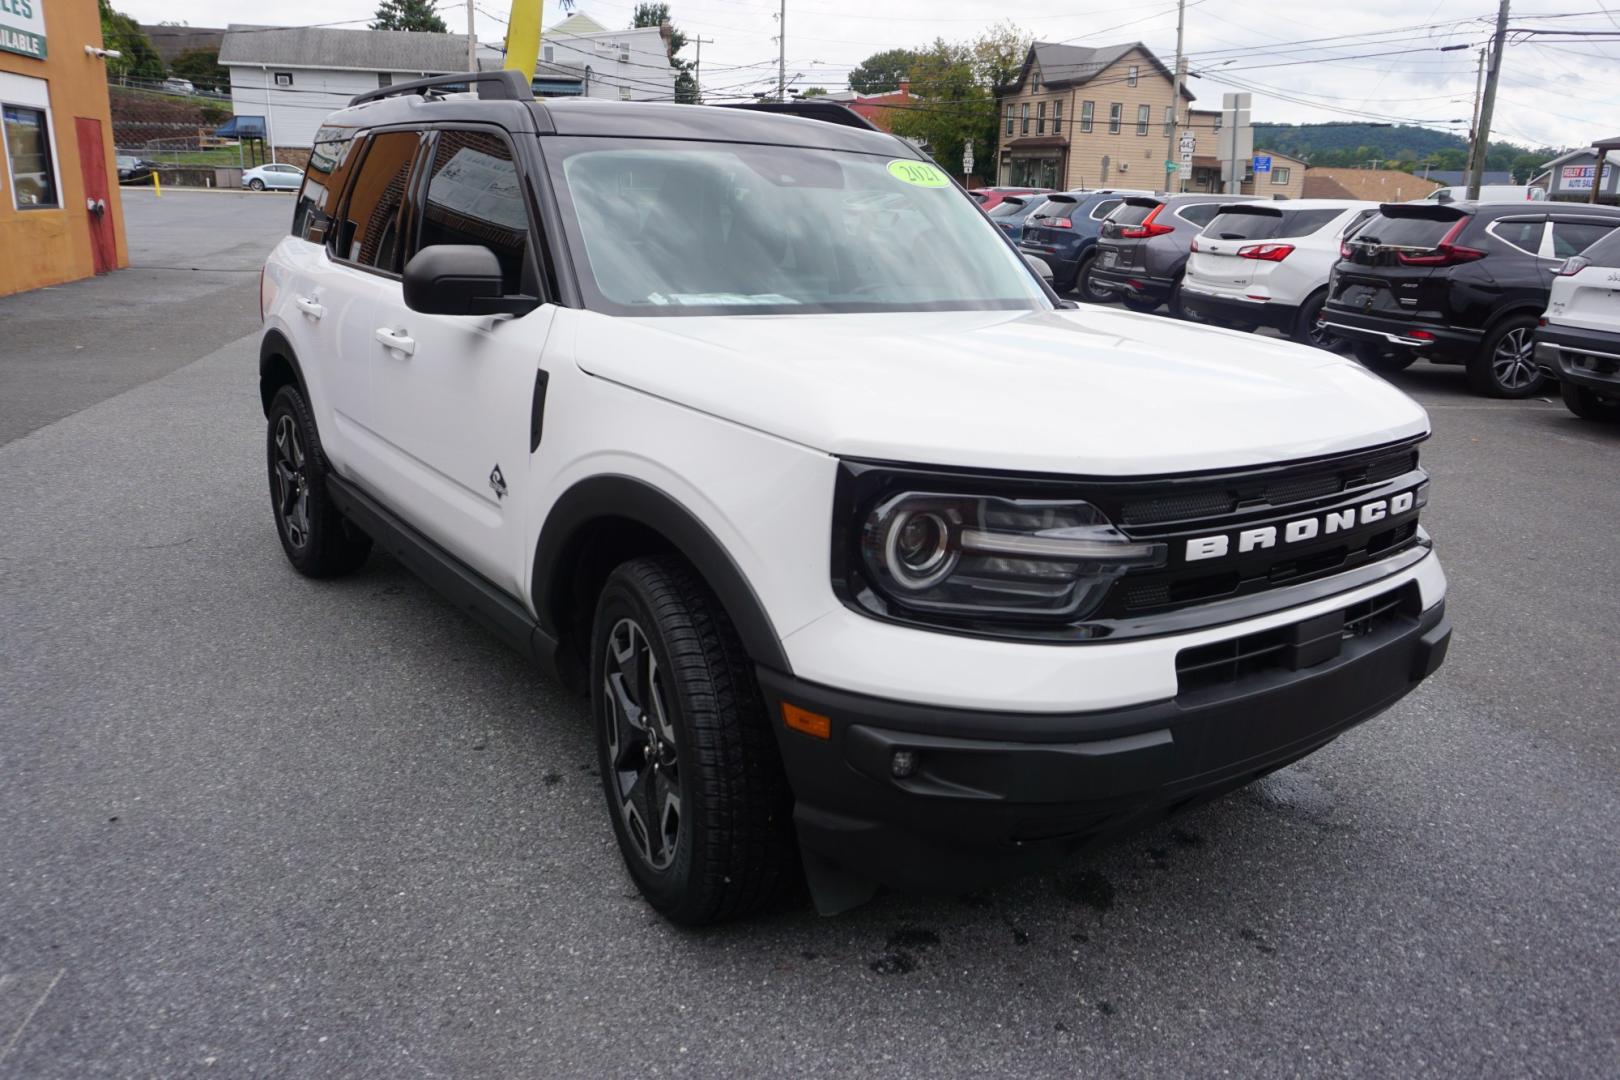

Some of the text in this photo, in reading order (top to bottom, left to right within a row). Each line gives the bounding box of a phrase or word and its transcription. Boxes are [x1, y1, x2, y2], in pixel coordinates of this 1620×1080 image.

[0, 29, 40, 55] ILABLE
[899, 165, 940, 181] 2021
[1185, 491, 1414, 562] BRONCO
